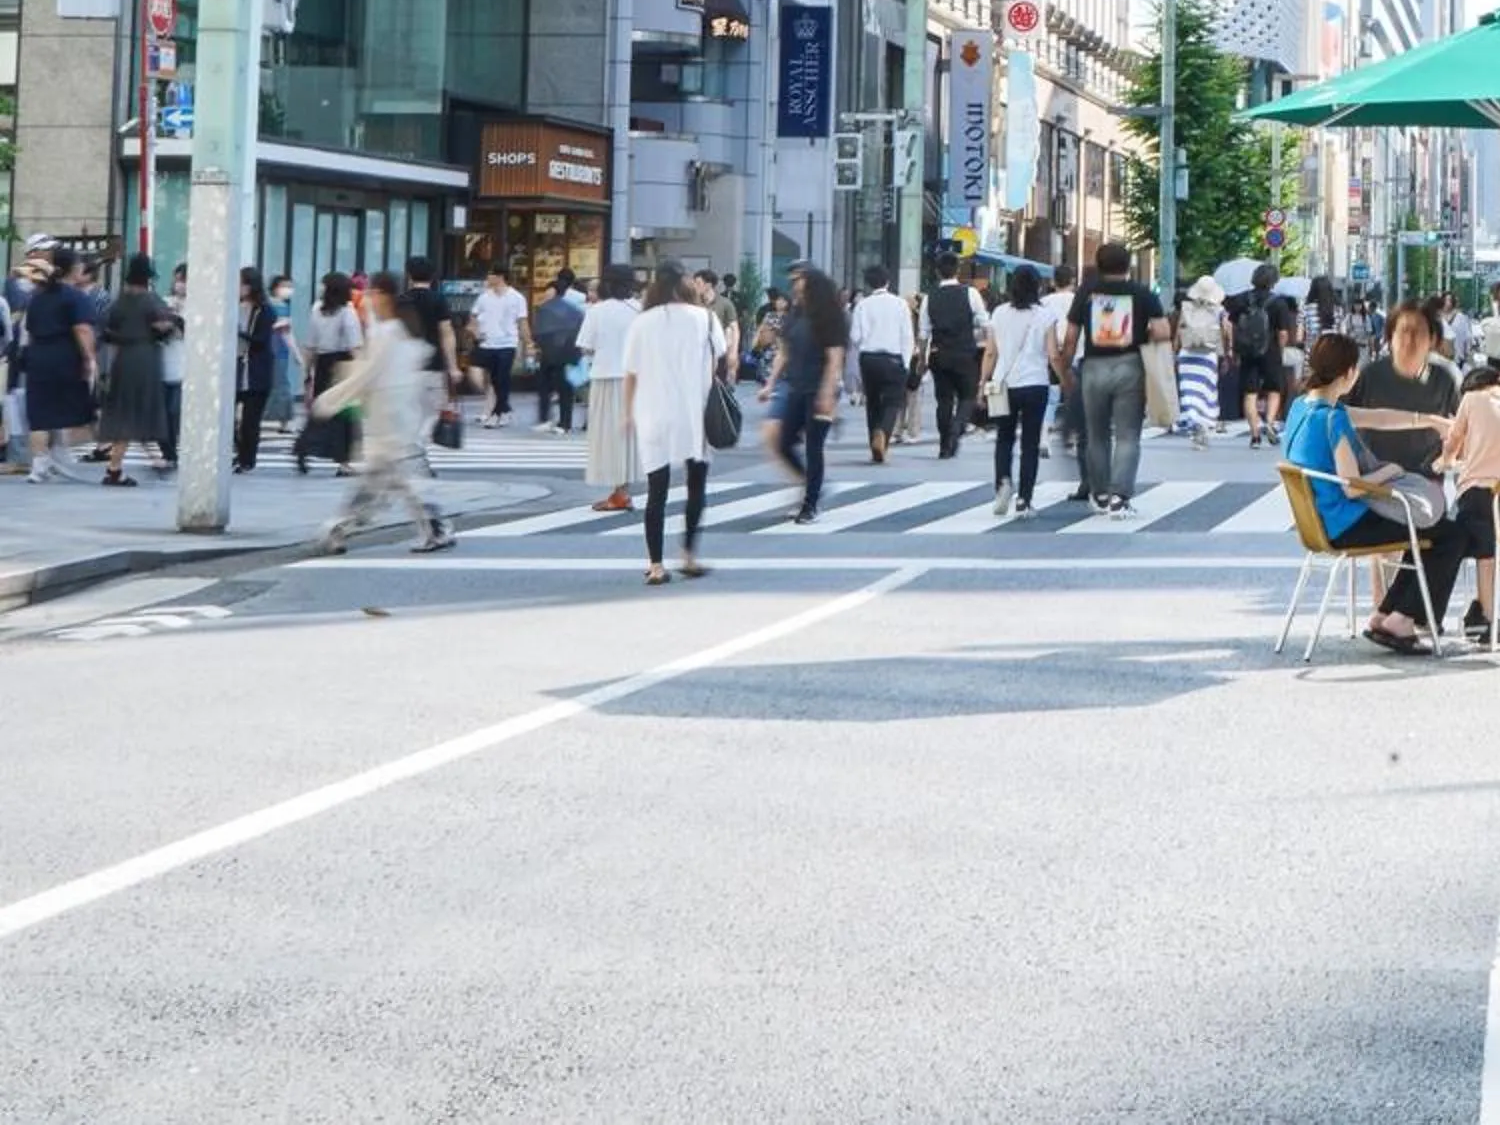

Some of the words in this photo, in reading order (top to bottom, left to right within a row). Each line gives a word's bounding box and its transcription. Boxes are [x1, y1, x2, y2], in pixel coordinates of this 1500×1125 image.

[788, 58, 803, 115] ROYAL
[803, 42, 820, 129] ASSCHER
[487, 152, 537, 165] SHOPS
